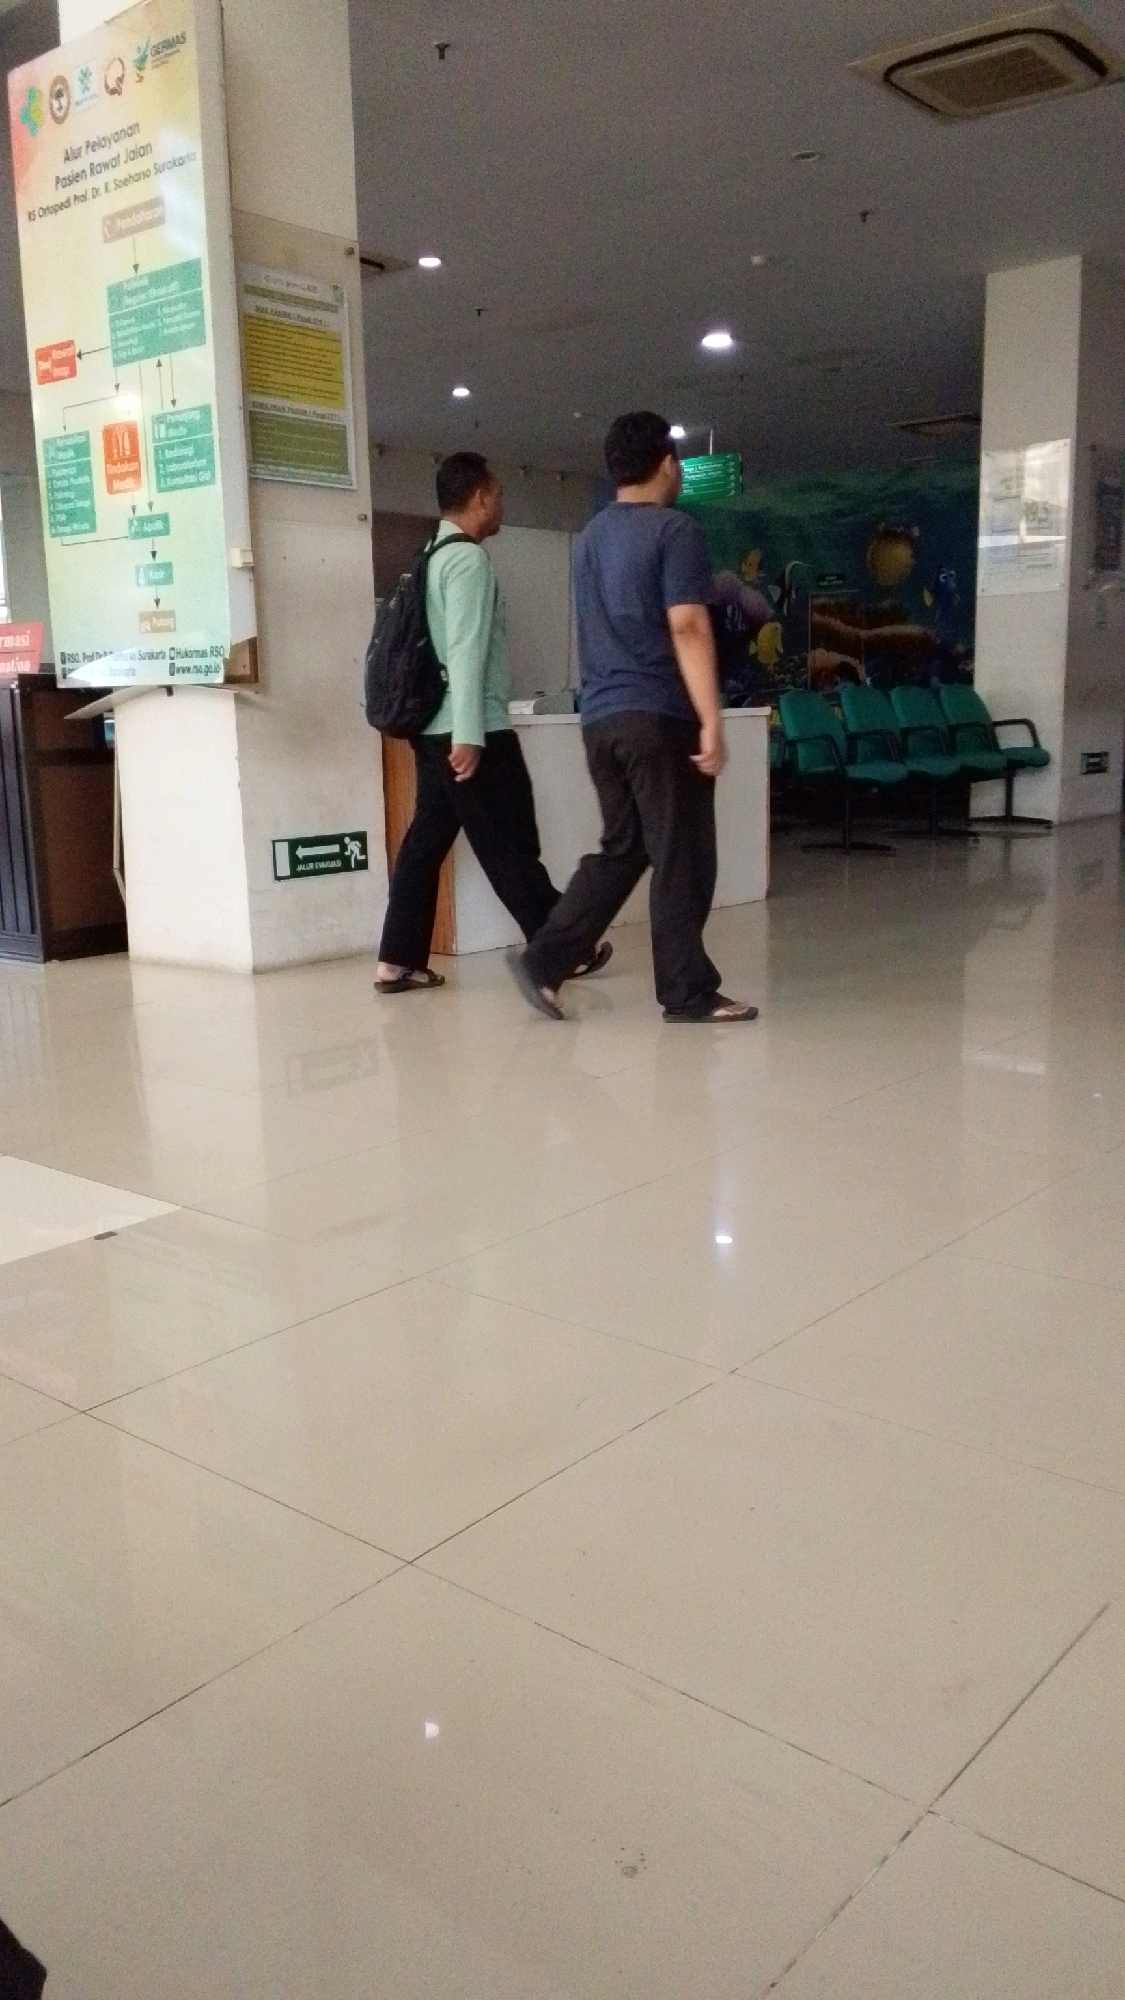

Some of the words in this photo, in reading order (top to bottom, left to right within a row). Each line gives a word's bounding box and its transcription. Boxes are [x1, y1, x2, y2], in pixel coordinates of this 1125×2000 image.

[150, 31, 187, 57] GERMAS
[63, 145, 82, 163] Alur
[85, 122, 140, 156] Pelayanan
[54, 167, 88, 191] Pasien
[89, 154, 121, 177] Rawat
[124, 142, 153, 164] Jalan
[37, 196, 71, 218] Ortopedi
[91, 186, 102, 199] Dr.
[104, 181, 111, 194] R.
[113, 167, 152, 190] Soeharso
[153, 150, 197, 175] Surakarta
[176, 646, 208, 660] Hukormas
[296, 863, 314, 871] JALUR
[315, 860, 341, 869] EVAKUASI
